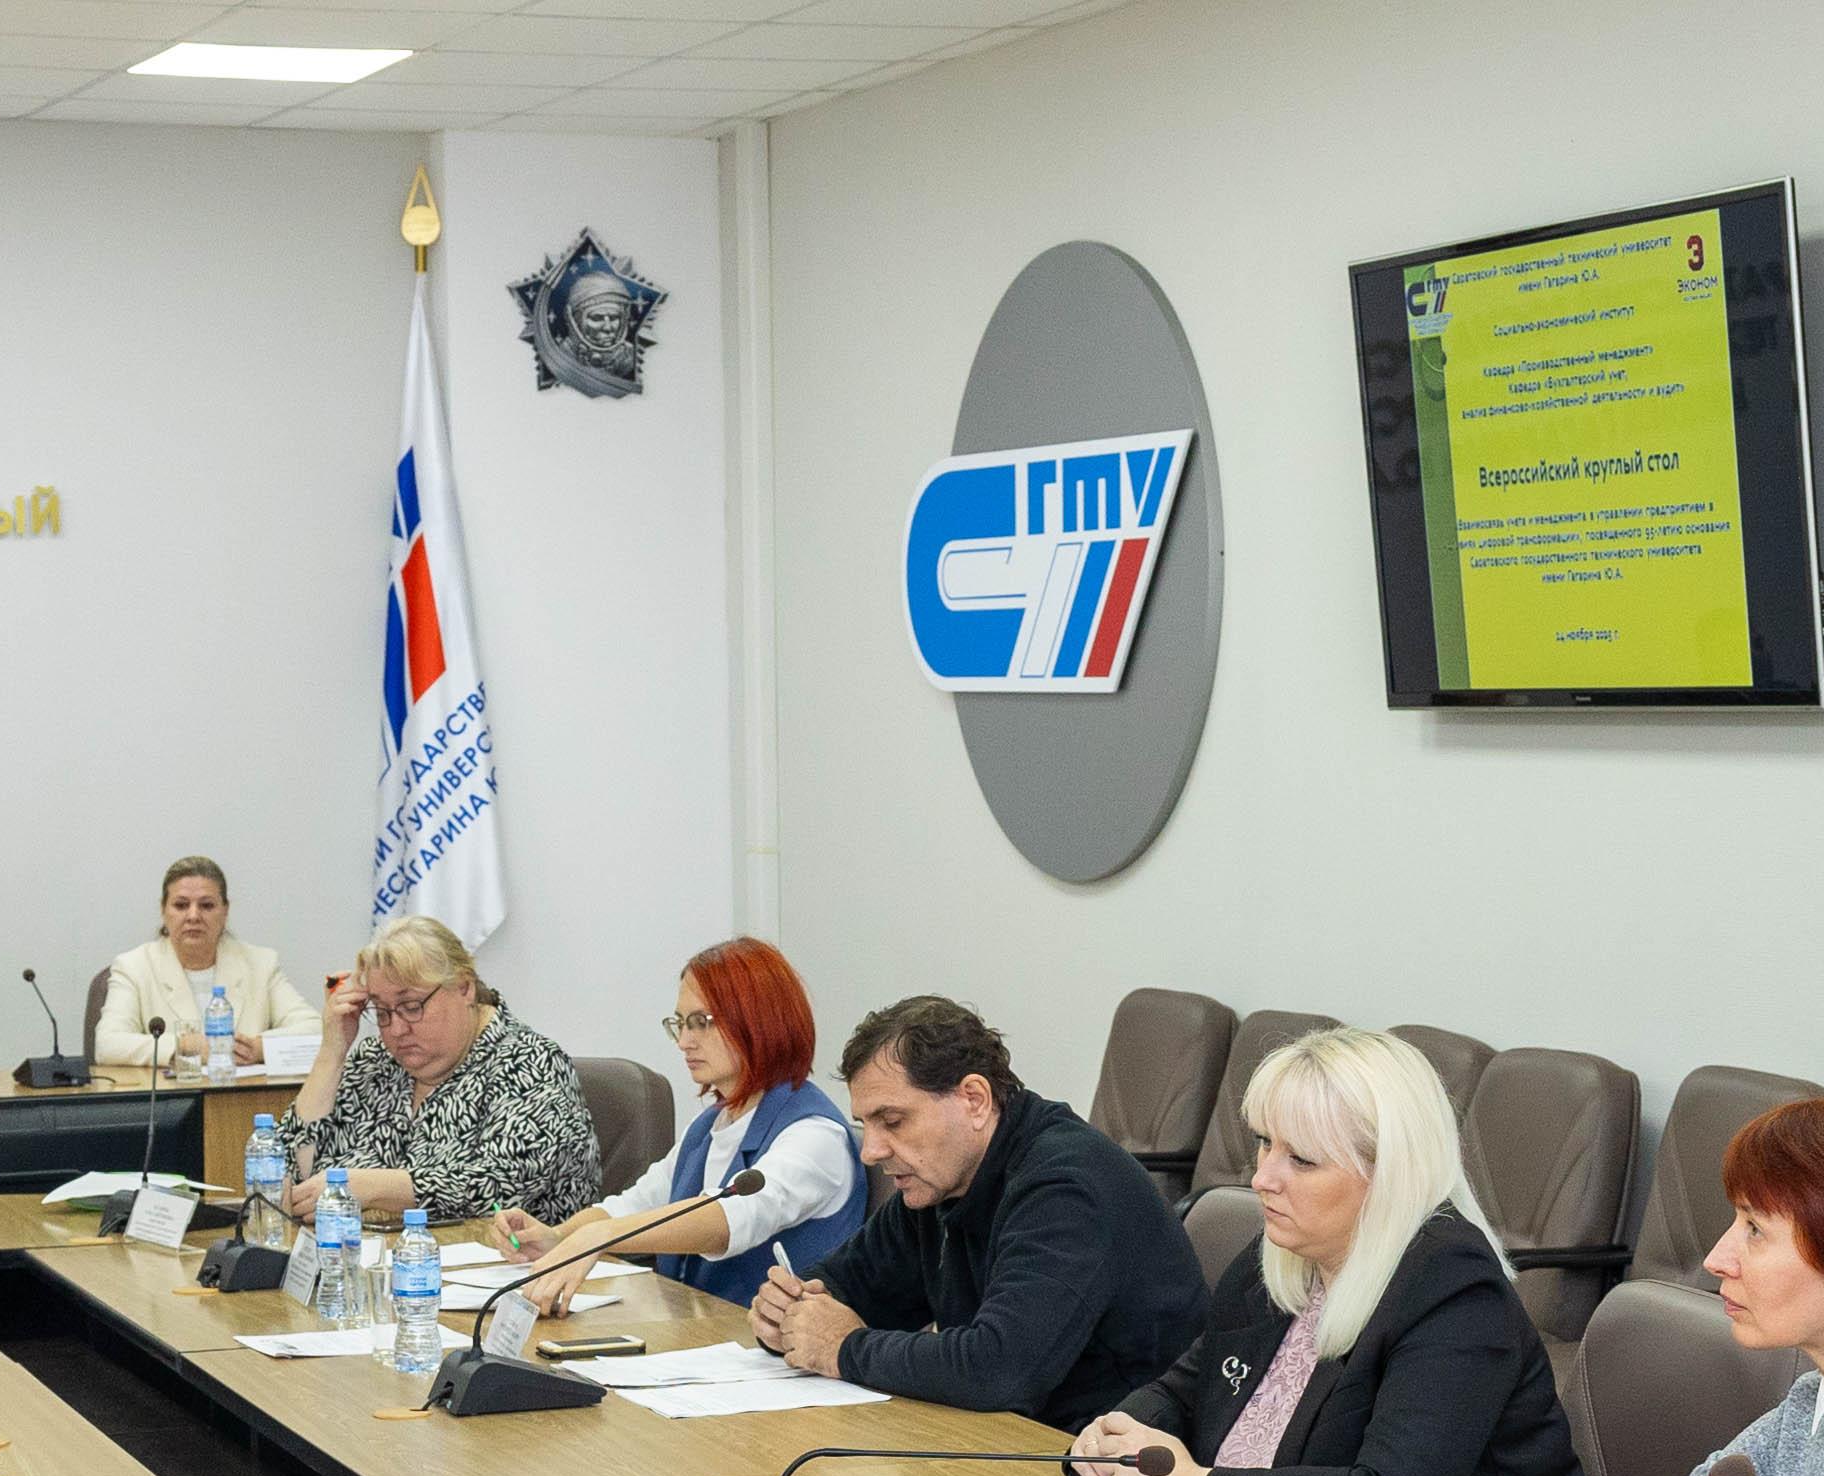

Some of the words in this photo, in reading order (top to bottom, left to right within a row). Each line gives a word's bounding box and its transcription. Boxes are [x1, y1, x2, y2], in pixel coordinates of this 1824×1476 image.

[1452, 266, 1498, 284] Саратовский
[1500, 253, 1565, 277] государственный
[1568, 243, 1618, 262] технический
[1622, 236, 1672, 256] университет
[1518, 281, 1542, 292] имени
[1544, 275, 1579, 289] Гагарина
[1677, 276, 1719, 293] ЭКОНОМ
[1493, 309, 1596, 336] Социально-экономический
[1599, 306, 1634, 322] институт
[1483, 365, 1515, 378] Кафедра
[1598, 345, 1654, 361] менеджмент»
[1508, 381, 1541, 394] Кафедра
[1592, 388, 1646, 404] деятельности
[1479, 456, 1580, 492] Всероссийский
[1584, 449, 1643, 485] круглый
[1647, 451, 1680, 472] стол
[1535, 511, 1586, 525] менеджмента
[1597, 507, 1643, 523] управлении
[1646, 502, 1705, 518] предприятием
[1479, 533, 1514, 549] цифровой
[1586, 527, 1642, 542] посвященного
[1685, 521, 1730, 534] основания
[1470, 555, 1518, 569] Саратовского
[1521, 551, 1588, 566] государственного
[1589, 547, 1644, 561] технического
[1647, 544, 1702, 561] университета
[1542, 572, 1565, 583] имени
[1567, 569, 1602, 583] Гагарина
[1567, 627, 1593, 643] ноября
